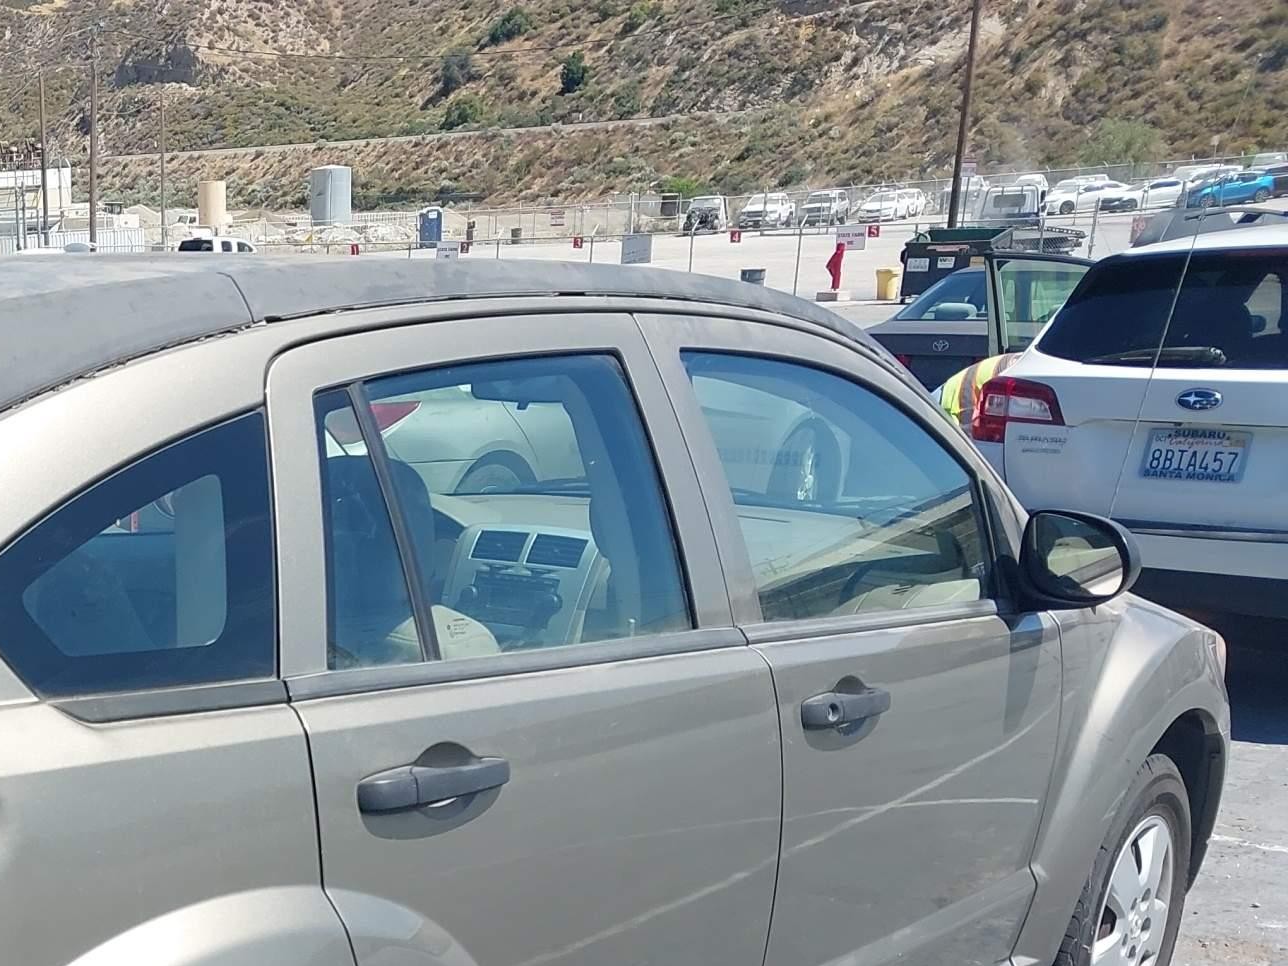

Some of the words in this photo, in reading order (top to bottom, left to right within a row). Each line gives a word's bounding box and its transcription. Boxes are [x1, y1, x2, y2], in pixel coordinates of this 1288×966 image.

[1174, 429, 1227, 440] SUBARU
[1149, 448, 1239, 475] 8BIA457
[1143, 468, 1182, 479] SANTA
[1186, 471, 1235, 482] MONICA
